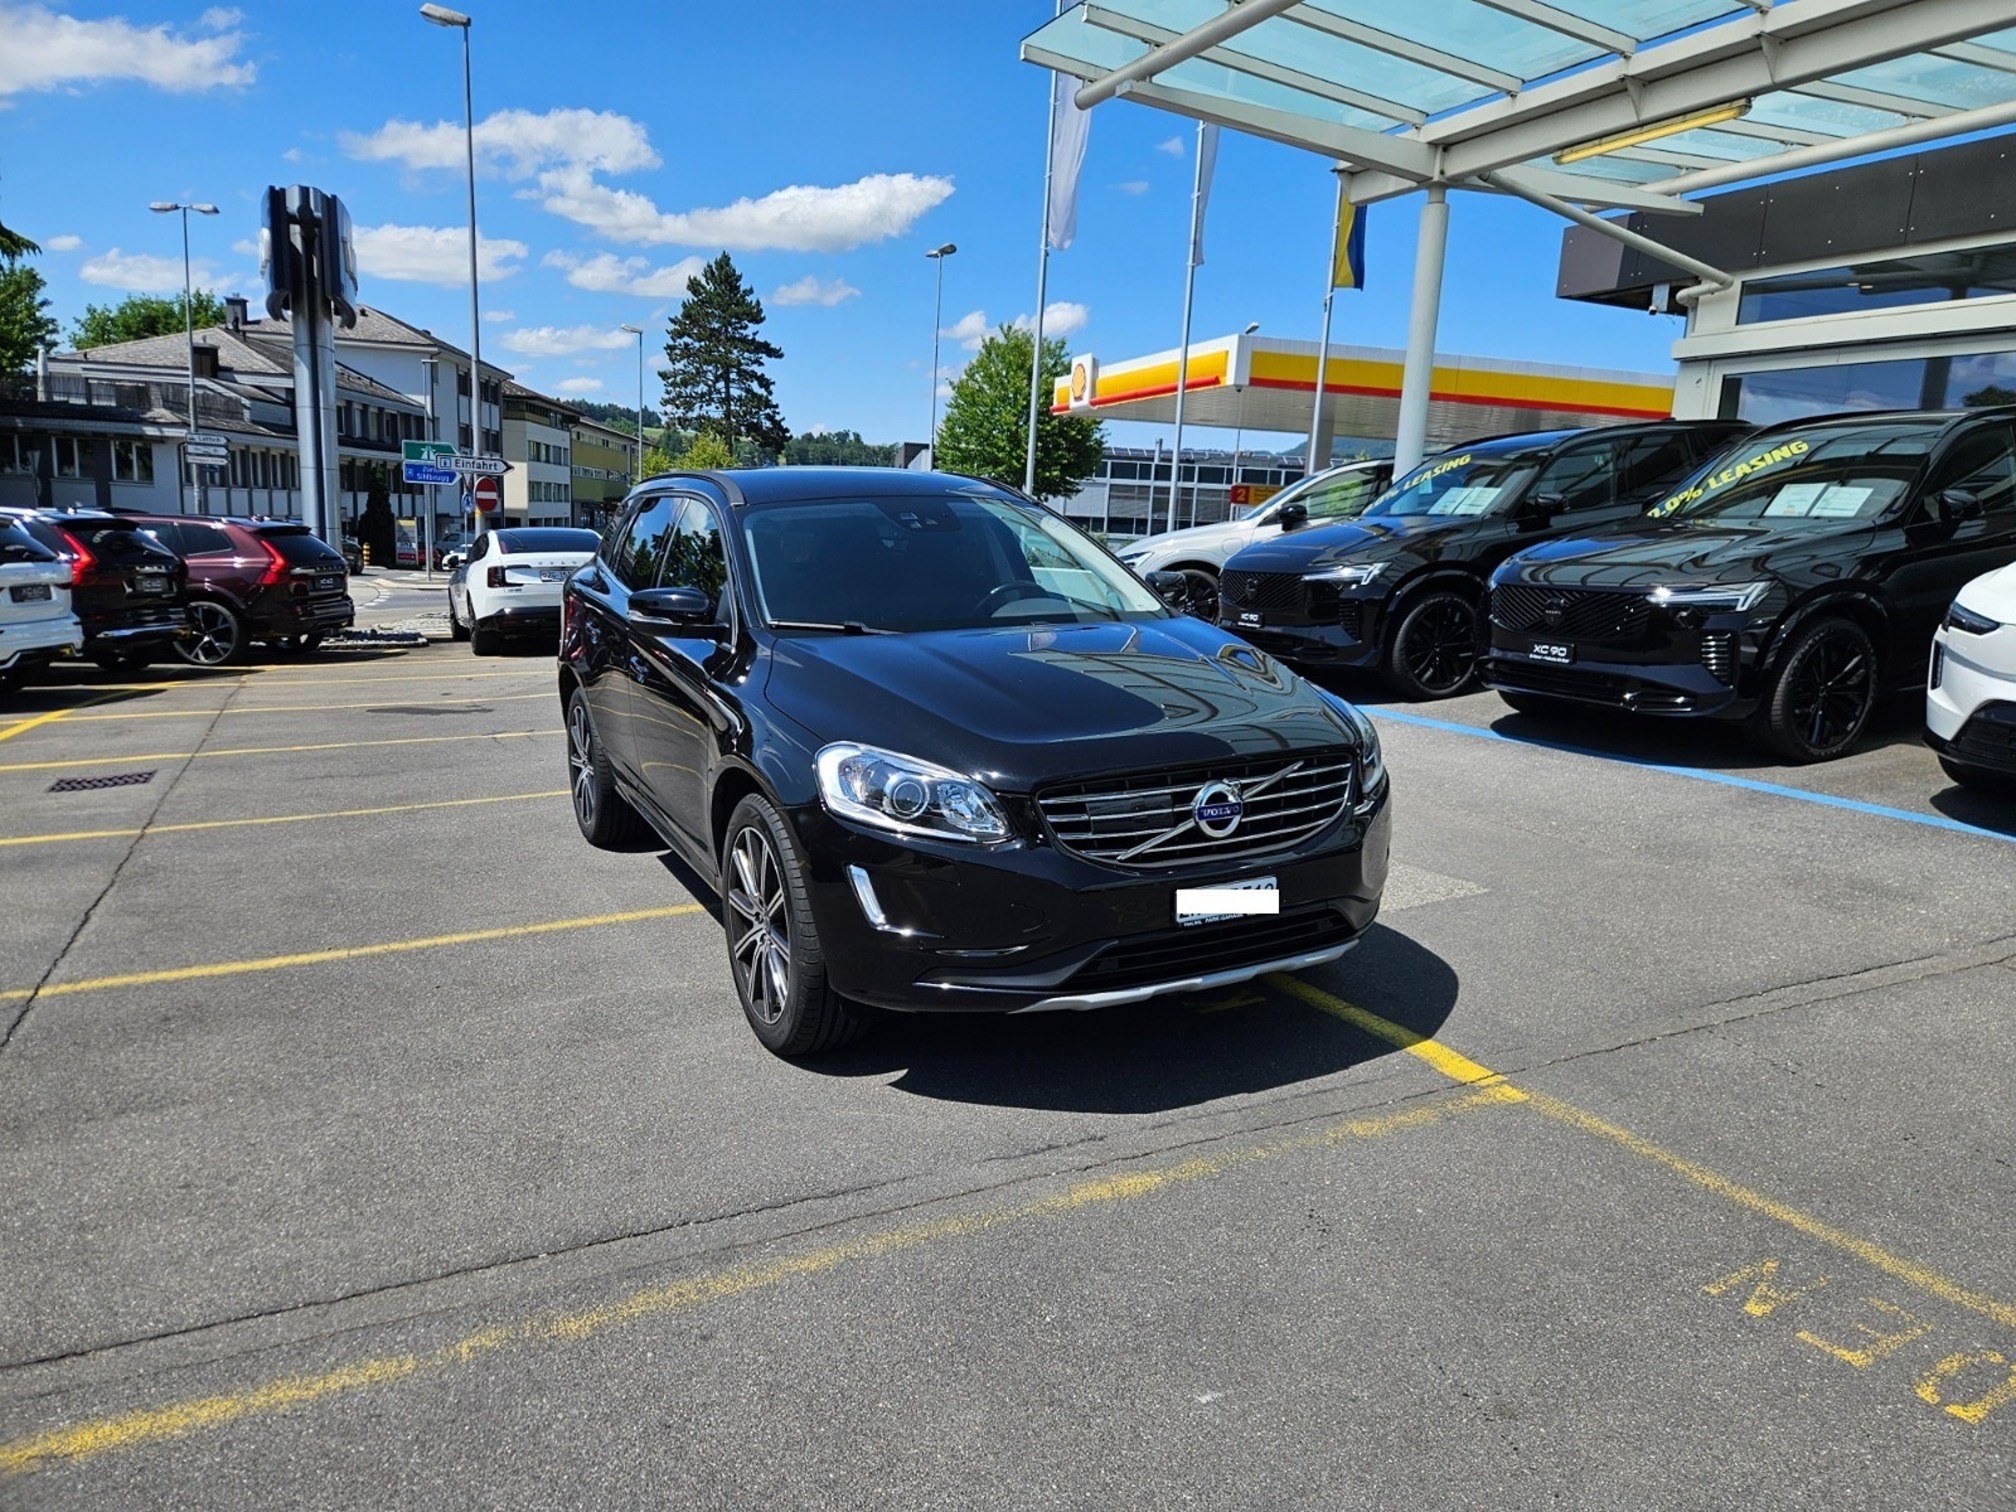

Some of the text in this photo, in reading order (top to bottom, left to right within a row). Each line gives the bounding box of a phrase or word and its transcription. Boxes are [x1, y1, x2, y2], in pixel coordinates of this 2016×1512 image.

[454, 458, 498, 472] Einfahrt
[1707, 439, 1809, 490] LEASING
[416, 472, 450, 483] Sihlbrugg
[1403, 453, 1472, 491] LEASING
[1236, 488, 1246, 502] 2
[1200, 805, 1240, 817] VOLVO
